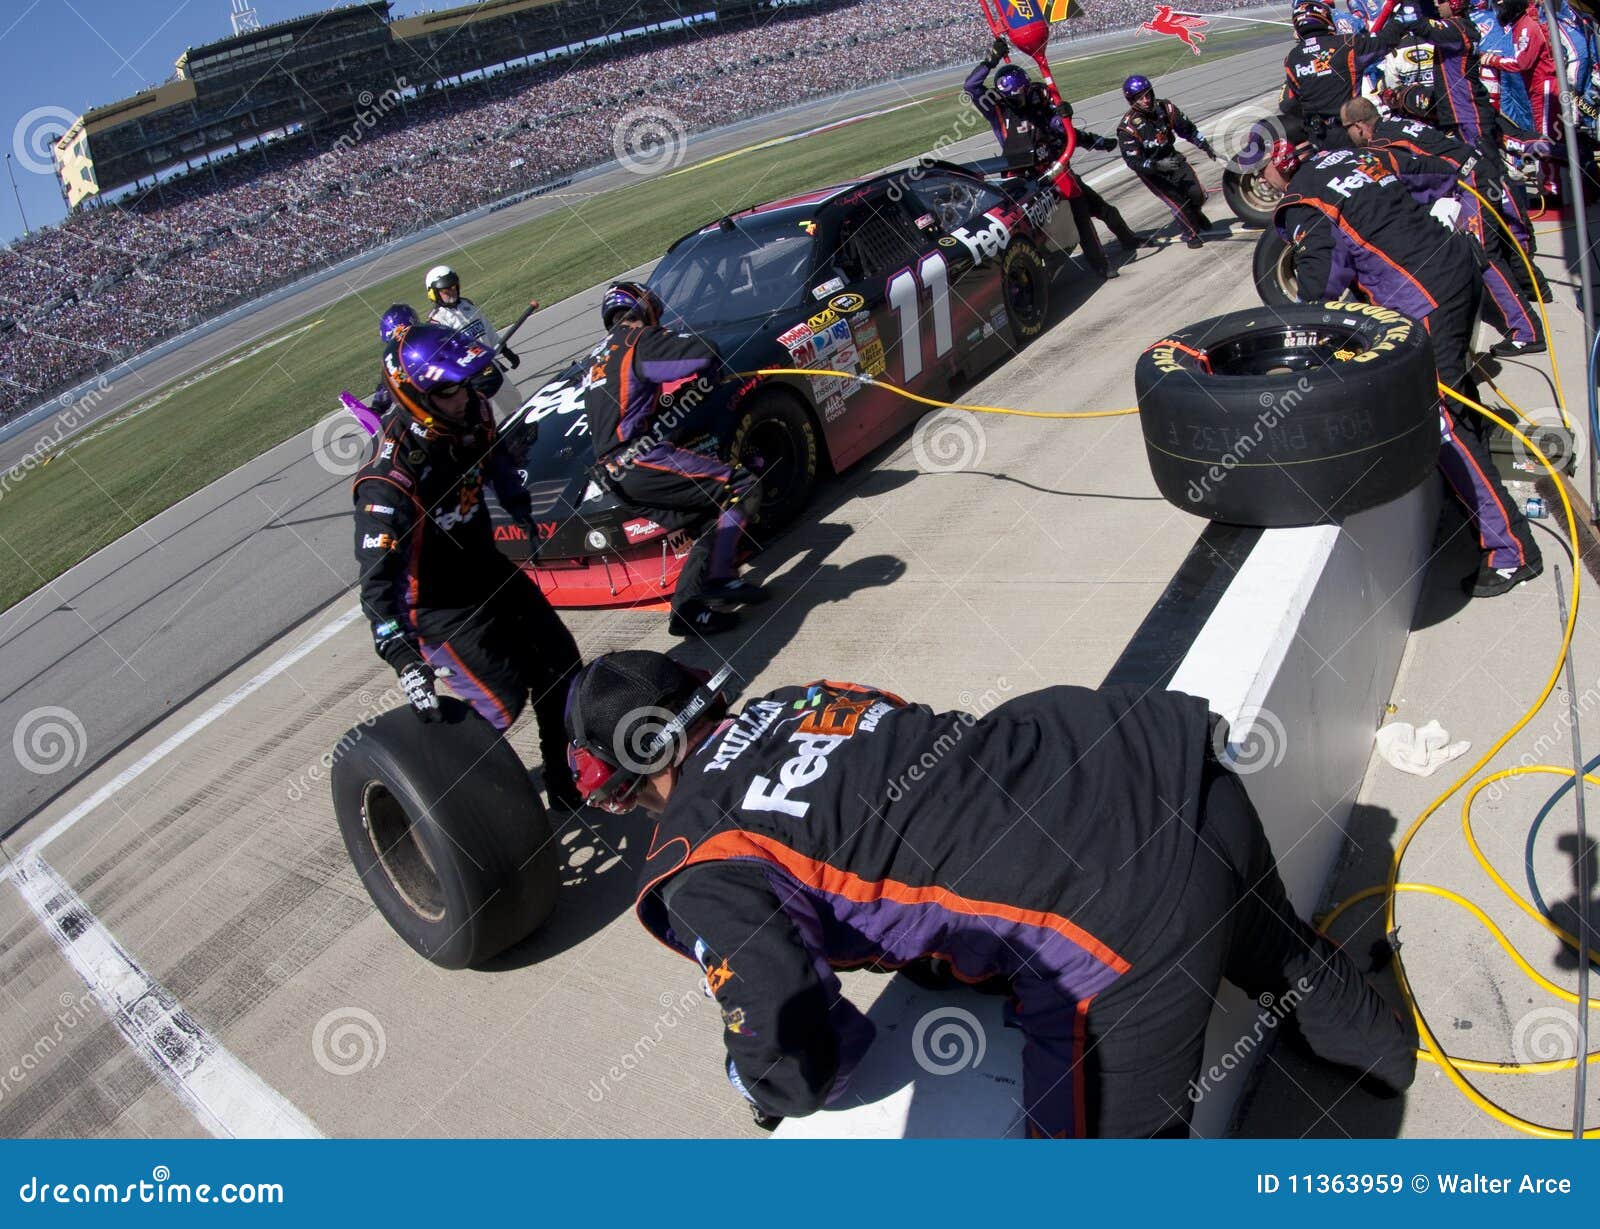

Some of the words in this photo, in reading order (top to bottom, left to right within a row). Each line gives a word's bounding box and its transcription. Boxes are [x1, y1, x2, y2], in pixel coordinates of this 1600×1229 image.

[1295, 59, 1330, 77] FedEx
[1326, 160, 1392, 198] FedEx
[780, 324, 811, 346] Holley
[885, 249, 952, 384] 11
[362, 533, 398, 550] FedEx
[703, 700, 788, 774] MULLEN
[741, 696, 877, 819] FedEx
